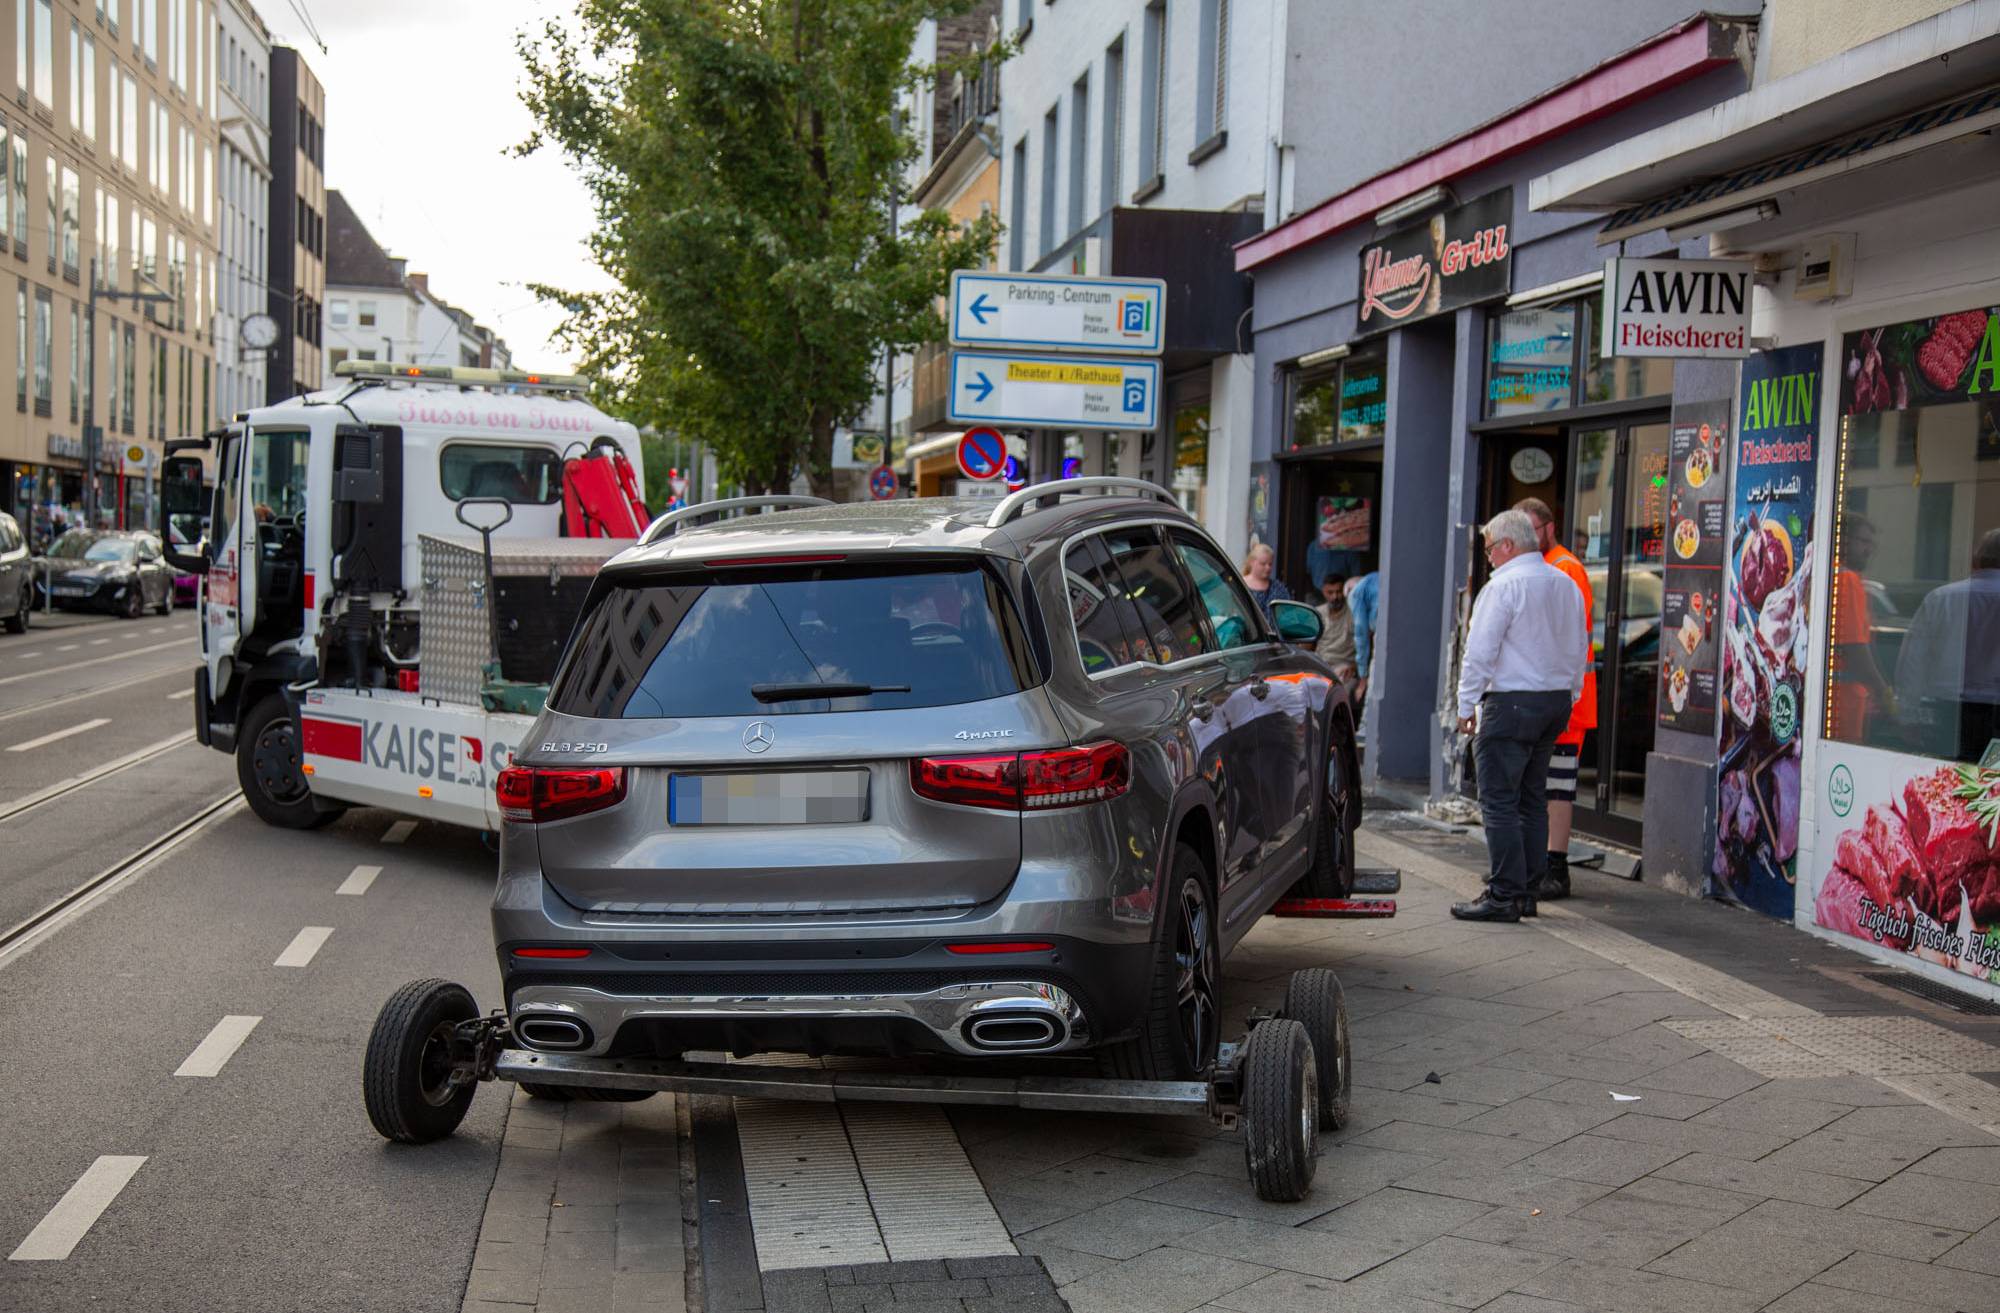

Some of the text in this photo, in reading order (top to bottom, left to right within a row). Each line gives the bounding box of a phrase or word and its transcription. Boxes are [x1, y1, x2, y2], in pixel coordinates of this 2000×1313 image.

[1441, 224, 1509, 276] Grill
[1008, 284, 1055, 305] Parkring
[1063, 287, 1112, 304] Centrum
[1622, 270, 1748, 314] AWIN
[1622, 322, 1744, 349] Fleischerei
[1008, 363, 1051, 379] Theater
[1743, 372, 1816, 431] AWIN
[486, 413, 520, 428] on
[1742, 434, 1812, 466] Fleischerei
[573, 742, 608, 753] 250
[954, 729, 1015, 740] 4MATIC
[1860, 898, 1909, 940] Täglich
[1908, 913, 1964, 957] frisches
